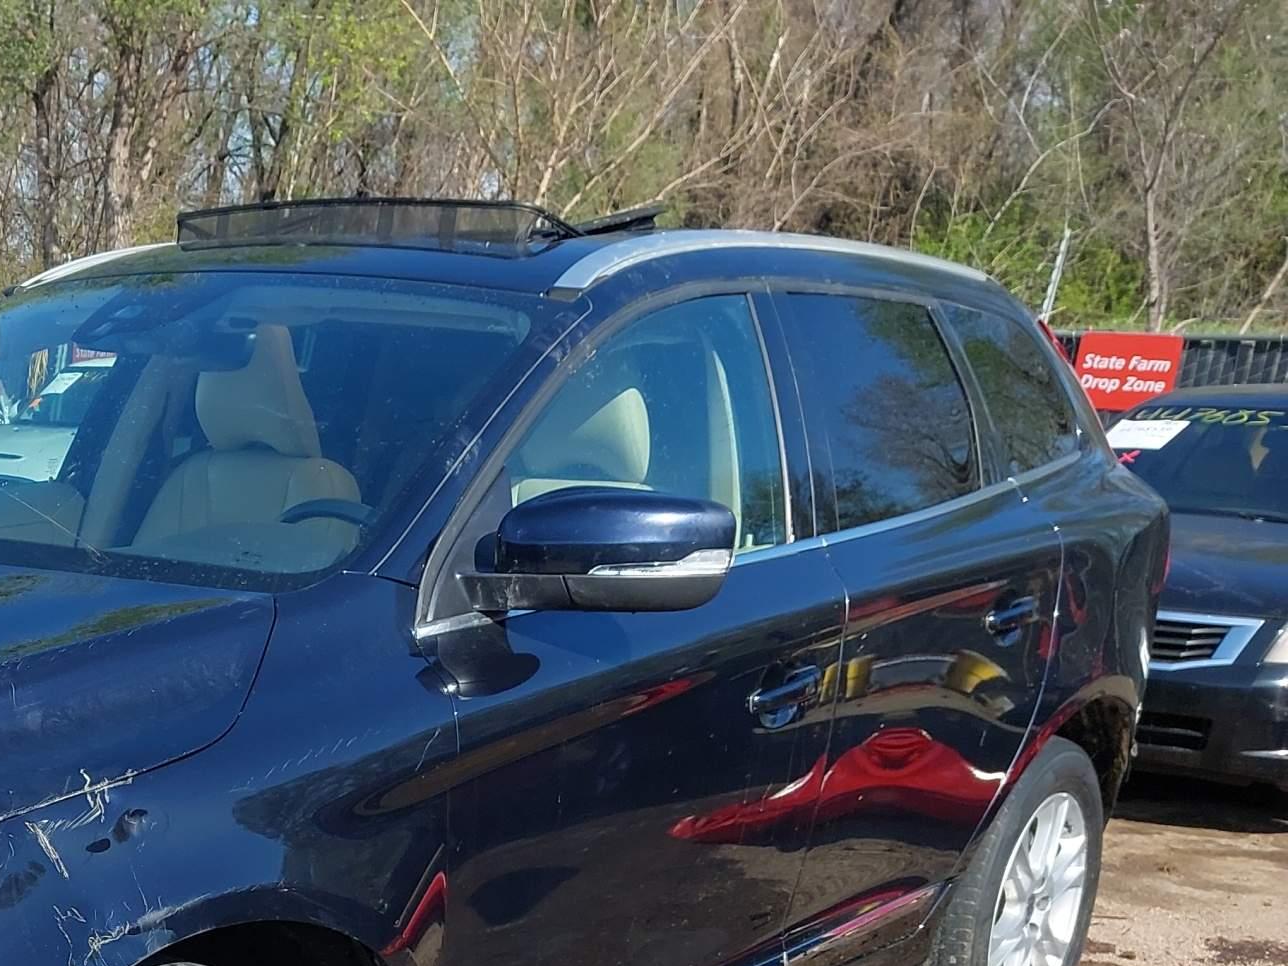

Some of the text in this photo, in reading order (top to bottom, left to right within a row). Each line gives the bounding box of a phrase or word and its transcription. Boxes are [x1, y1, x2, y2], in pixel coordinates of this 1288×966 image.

[1082, 353, 1172, 373] State Farm
[1080, 374, 1166, 394] Drop Zone
